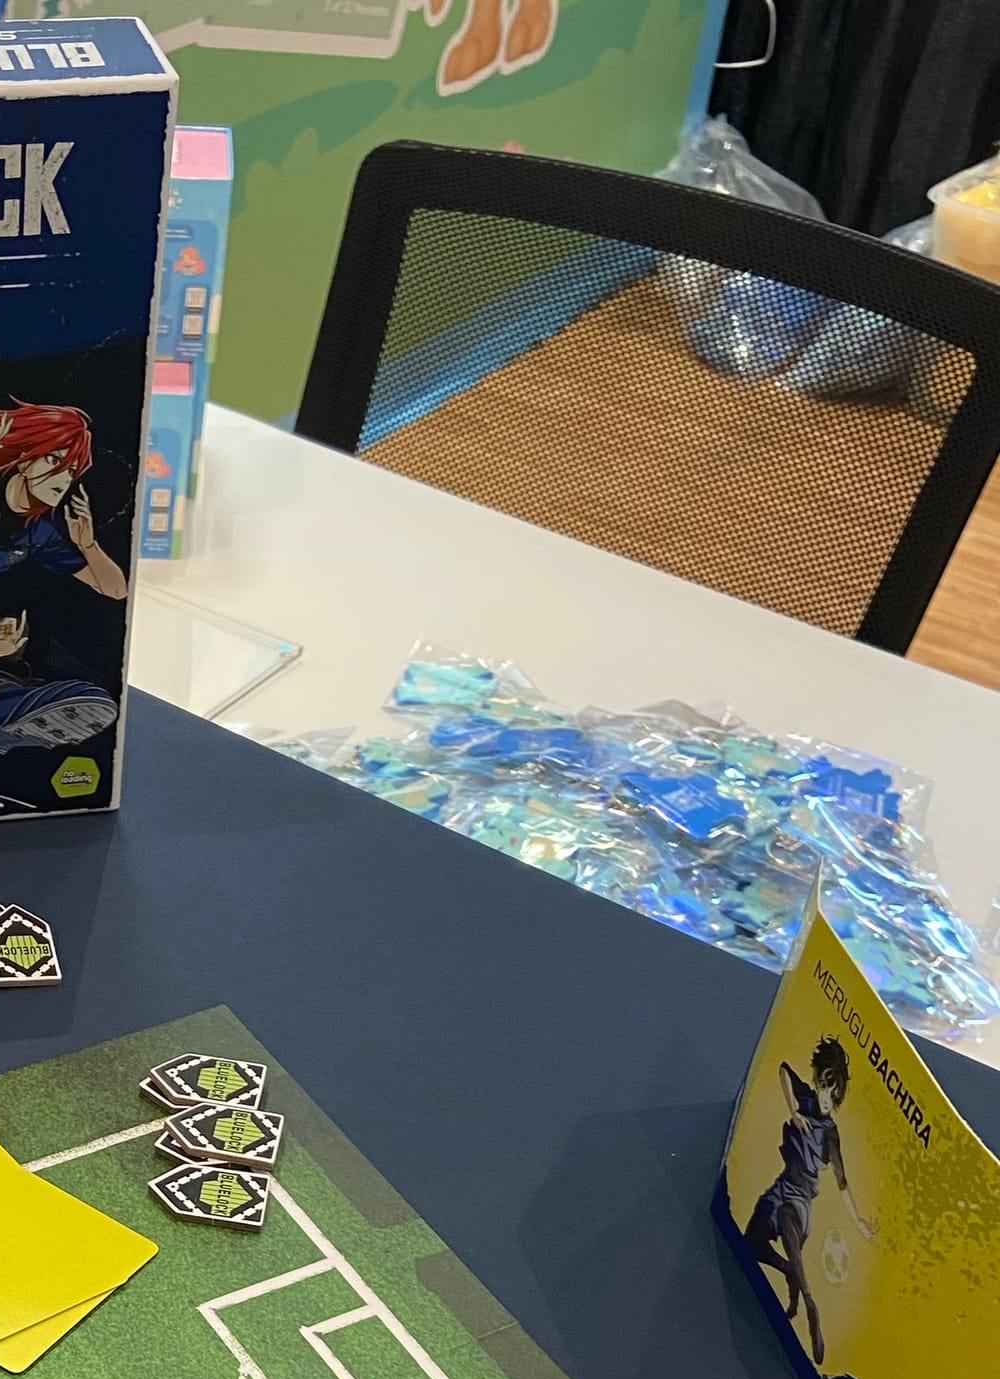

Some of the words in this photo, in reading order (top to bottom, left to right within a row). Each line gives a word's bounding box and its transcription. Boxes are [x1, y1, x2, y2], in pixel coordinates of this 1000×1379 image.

[813, 959, 871, 1048] MERUGU
[868, 1041, 932, 1149] BACHIRA
[208, 1061, 232, 1100] BLUELOCK
[226, 1110, 248, 1151] BLUELOCK
[212, 1173, 235, 1216] BLUELOCK
